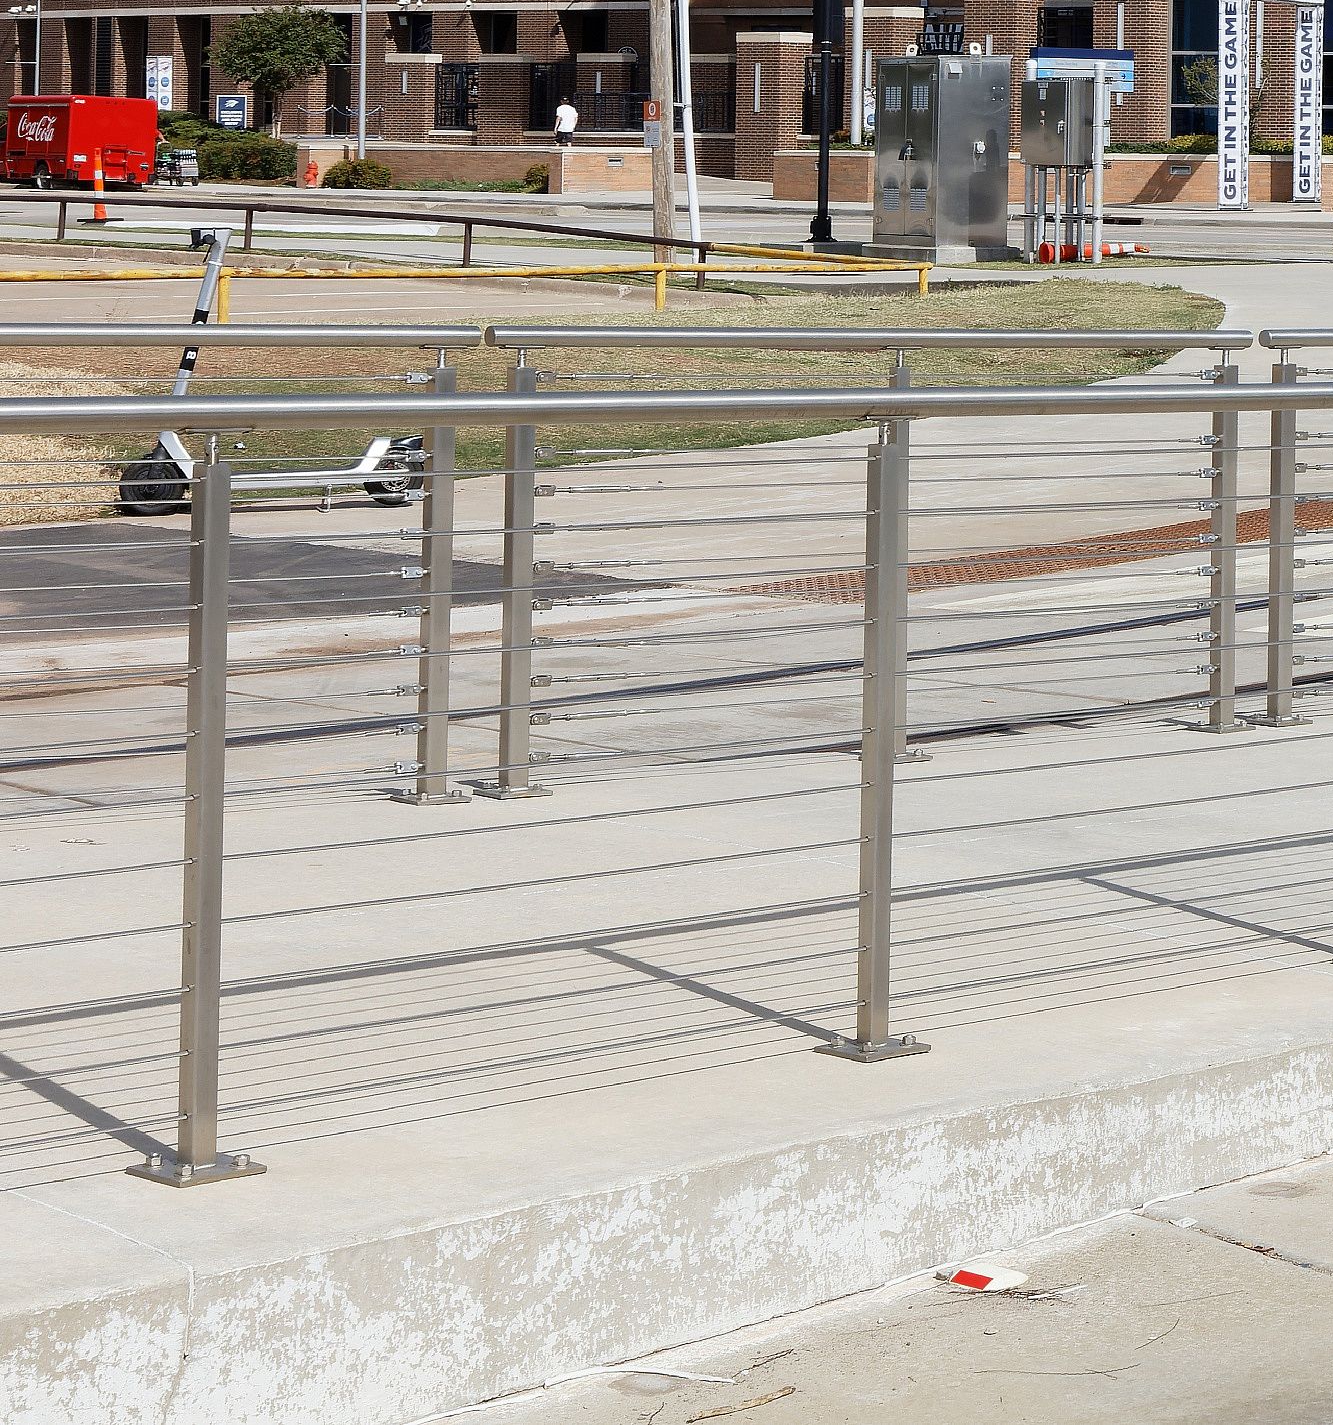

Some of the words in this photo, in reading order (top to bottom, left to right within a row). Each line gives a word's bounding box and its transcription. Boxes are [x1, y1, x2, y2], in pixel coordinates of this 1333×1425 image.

[1225, 2, 1237, 69] GAME
[1300, 10, 1313, 73] GAME
[1225, 74, 1237, 121] THE
[1300, 78, 1312, 121] THE
[1224, 127, 1236, 149] IN
[1300, 125, 1311, 146] IN
[1224, 154, 1236, 199] GET
[1299, 151, 1311, 193] GET
